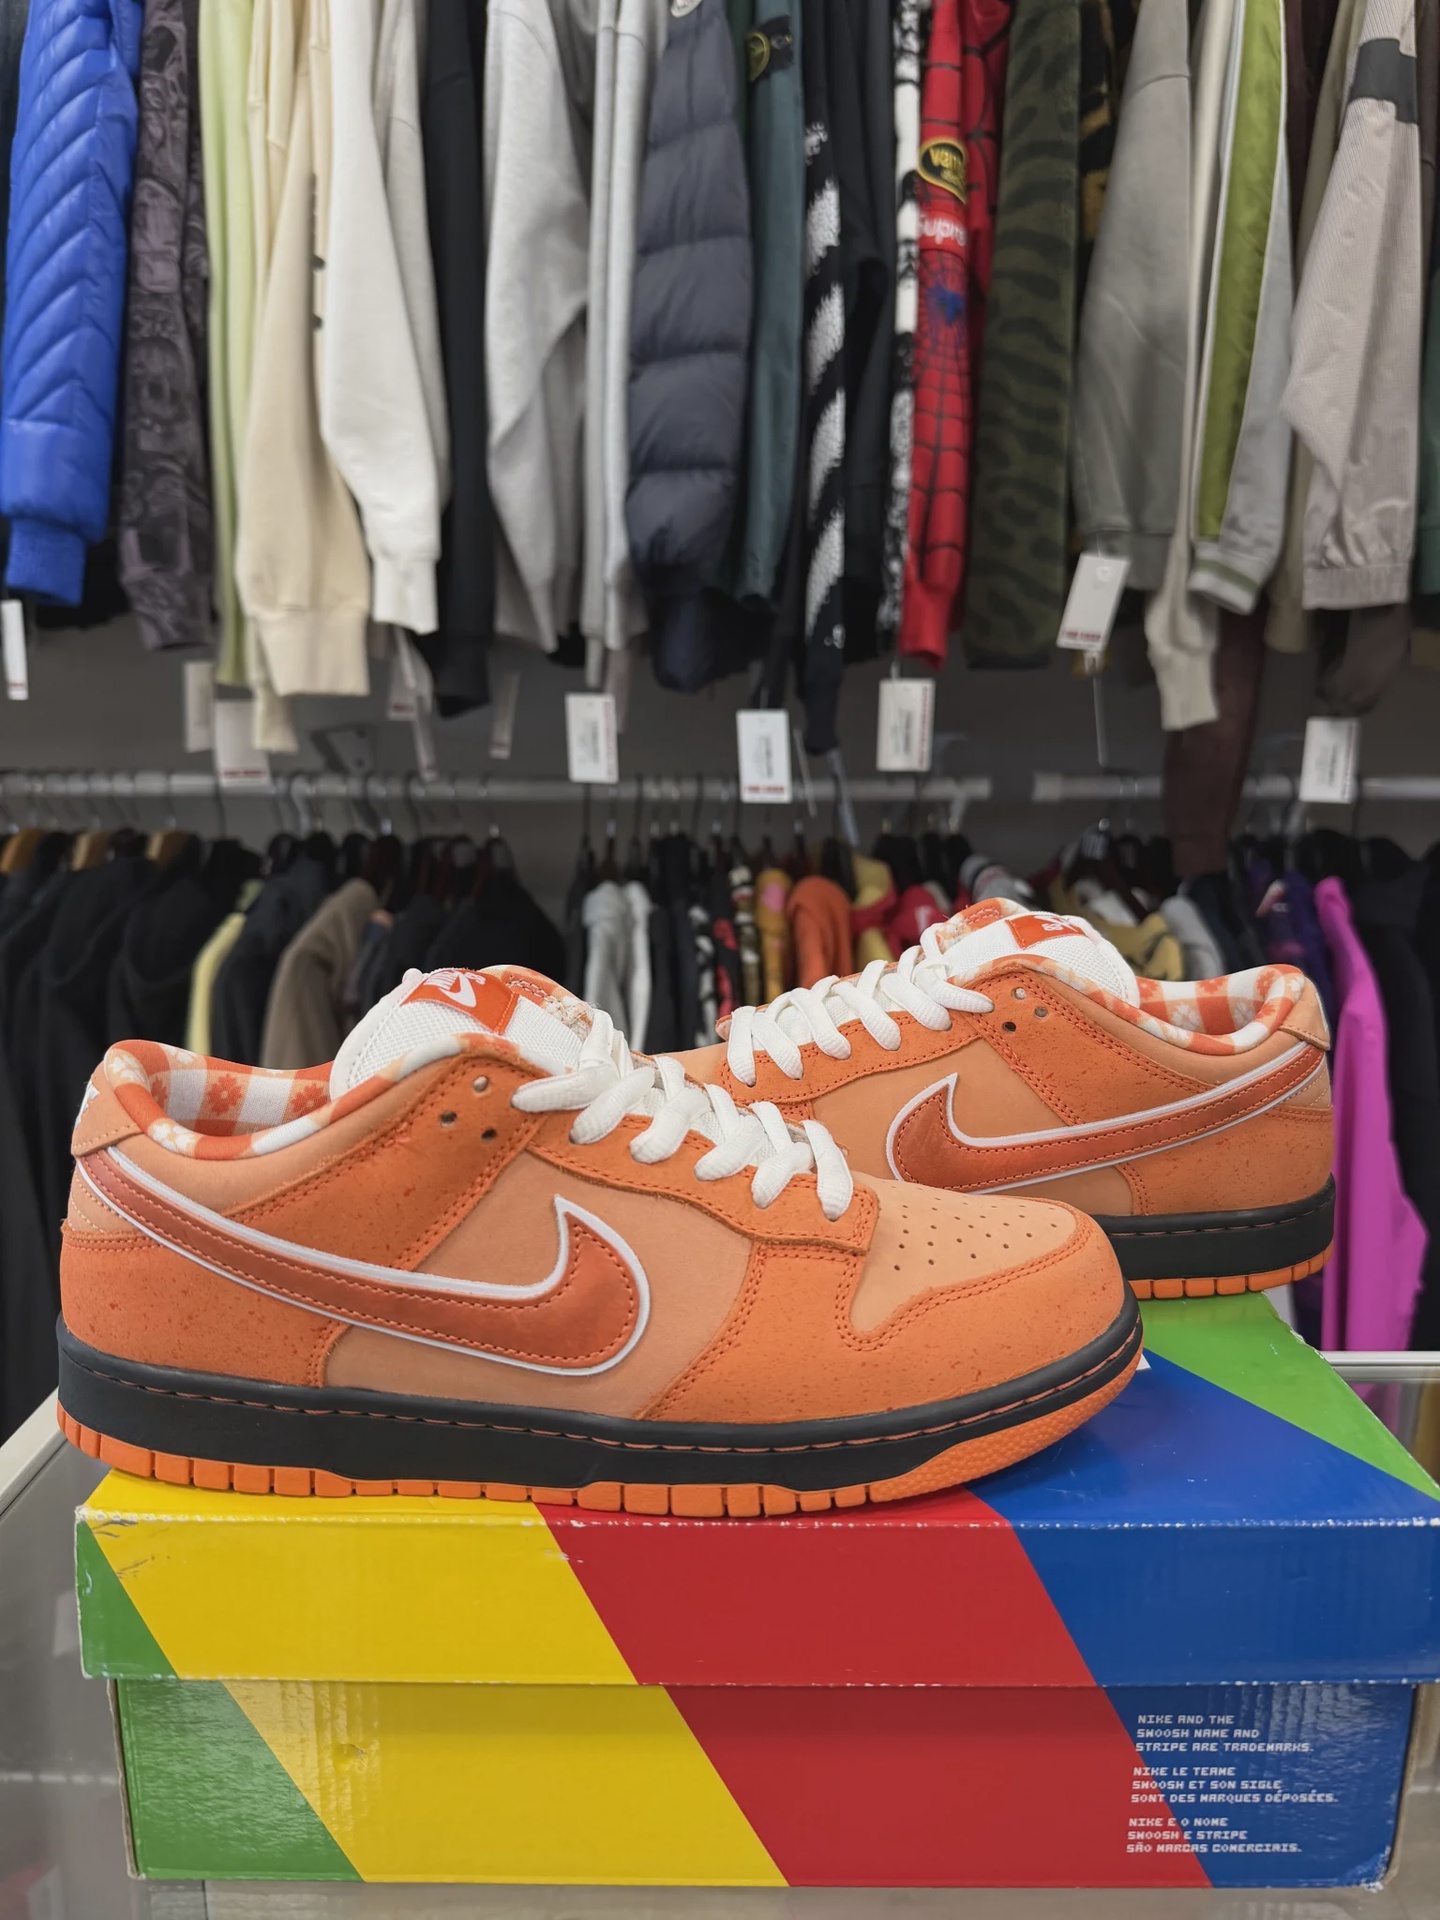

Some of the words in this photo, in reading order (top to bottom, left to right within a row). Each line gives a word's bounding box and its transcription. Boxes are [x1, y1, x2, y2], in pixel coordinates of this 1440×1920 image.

[1138, 1715, 1173, 1724] NIKE
[1178, 1715, 1204, 1724] AND
[1209, 1715, 1234, 1724] THE
[1137, 1729, 1189, 1738] SWOOSH
[1194, 1729, 1229, 1738] NAME
[1234, 1729, 1260, 1738] AND
[1135, 1743, 1187, 1752] STRIPE
[1192, 1743, 1218, 1752] ARE
[1223, 1743, 1314, 1753] TRADEMARKS.
[1133, 1767, 1169, 1776] NIKE
[1173, 1767, 1188, 1776] LE
[1132, 1781, 1184, 1789] SWOOSH
[1189, 1781, 1206, 1789] ET
[1210, 1781, 1236, 1789] SON
[1241, 1781, 1282, 1790] SIGLE
[1131, 1794, 1165, 1803] SONT
[1170, 1794, 1196, 1803] DES
[1200, 1794, 1261, 1804] MARQUES
[1129, 1818, 1163, 1826] NIKE
[1168, 1818, 1176, 1826] E
[1181, 1818, 1190, 1826] O
[1194, 1818, 1229, 1826] NOME
[1128, 1831, 1179, 1840] SWOOSH
[1184, 1831, 1192, 1839] E
[1197, 1830, 1248, 1839] STRIPE
[1126, 1842, 1152, 1853] SÃO
[1156, 1844, 1208, 1853] MARCAS
[1212, 1843, 1302, 1853] COMERCIAIS.
